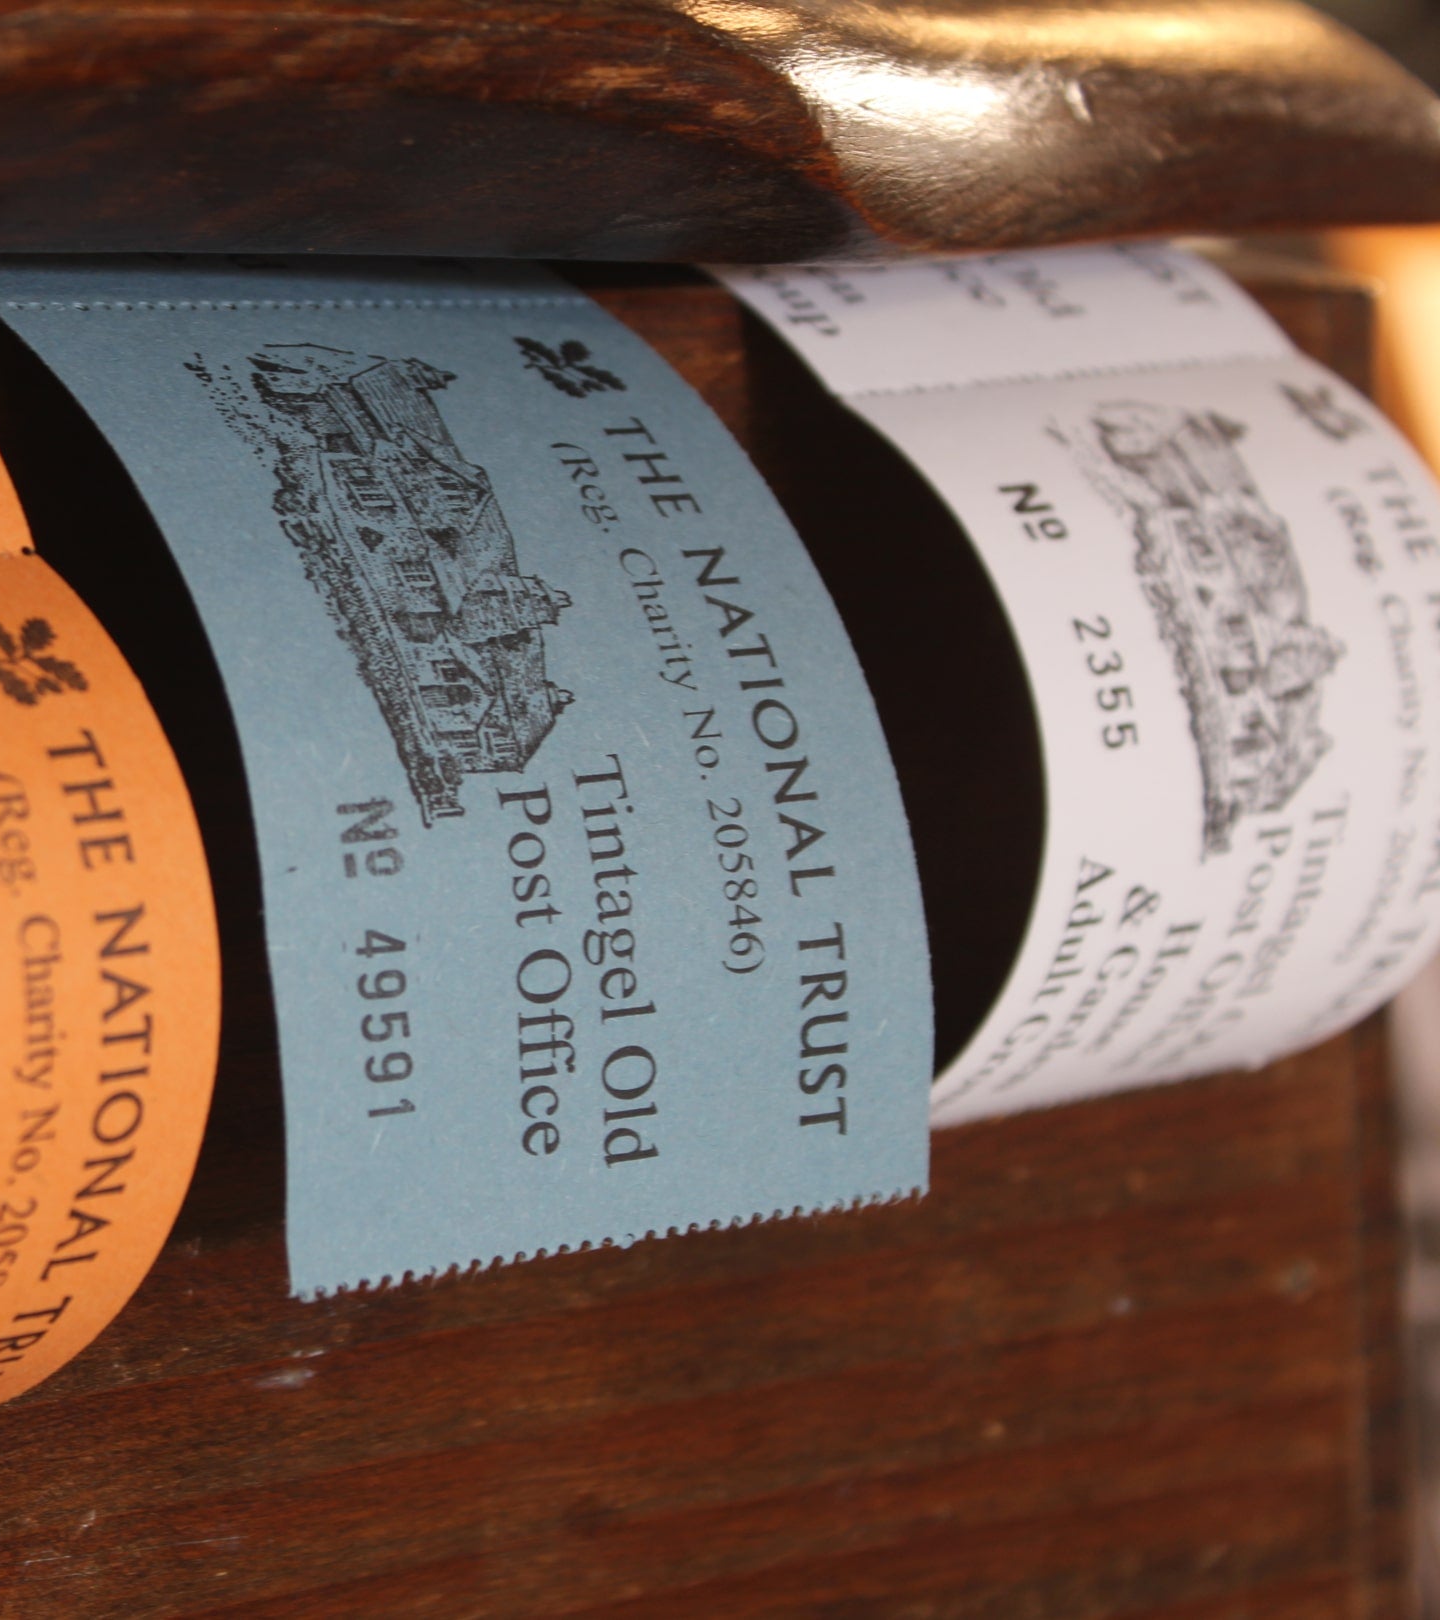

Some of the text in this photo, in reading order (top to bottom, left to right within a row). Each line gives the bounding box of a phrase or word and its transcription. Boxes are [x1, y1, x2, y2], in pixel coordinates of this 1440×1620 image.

[550, 441, 767, 976] (Reg. Charity No. 205846)
[1072, 615, 1139, 750] 2355
[45, 730, 135, 871] THE
[602, 416, 849, 1136] THE NATIONAL TRUST
[572, 753, 661, 1169] Tintagel Old
[1034, 856, 1115, 1004] Adult
[1118, 883, 1160, 930] &
[1227, 824, 1293, 937] Post
[15, 914, 62, 1092] Charity
[355, 929, 417, 1119] 49591
[495, 783, 577, 1157] Post Office
[8, 1104, 59, 1187] No.
[41, 902, 155, 1283] NATIONAL
